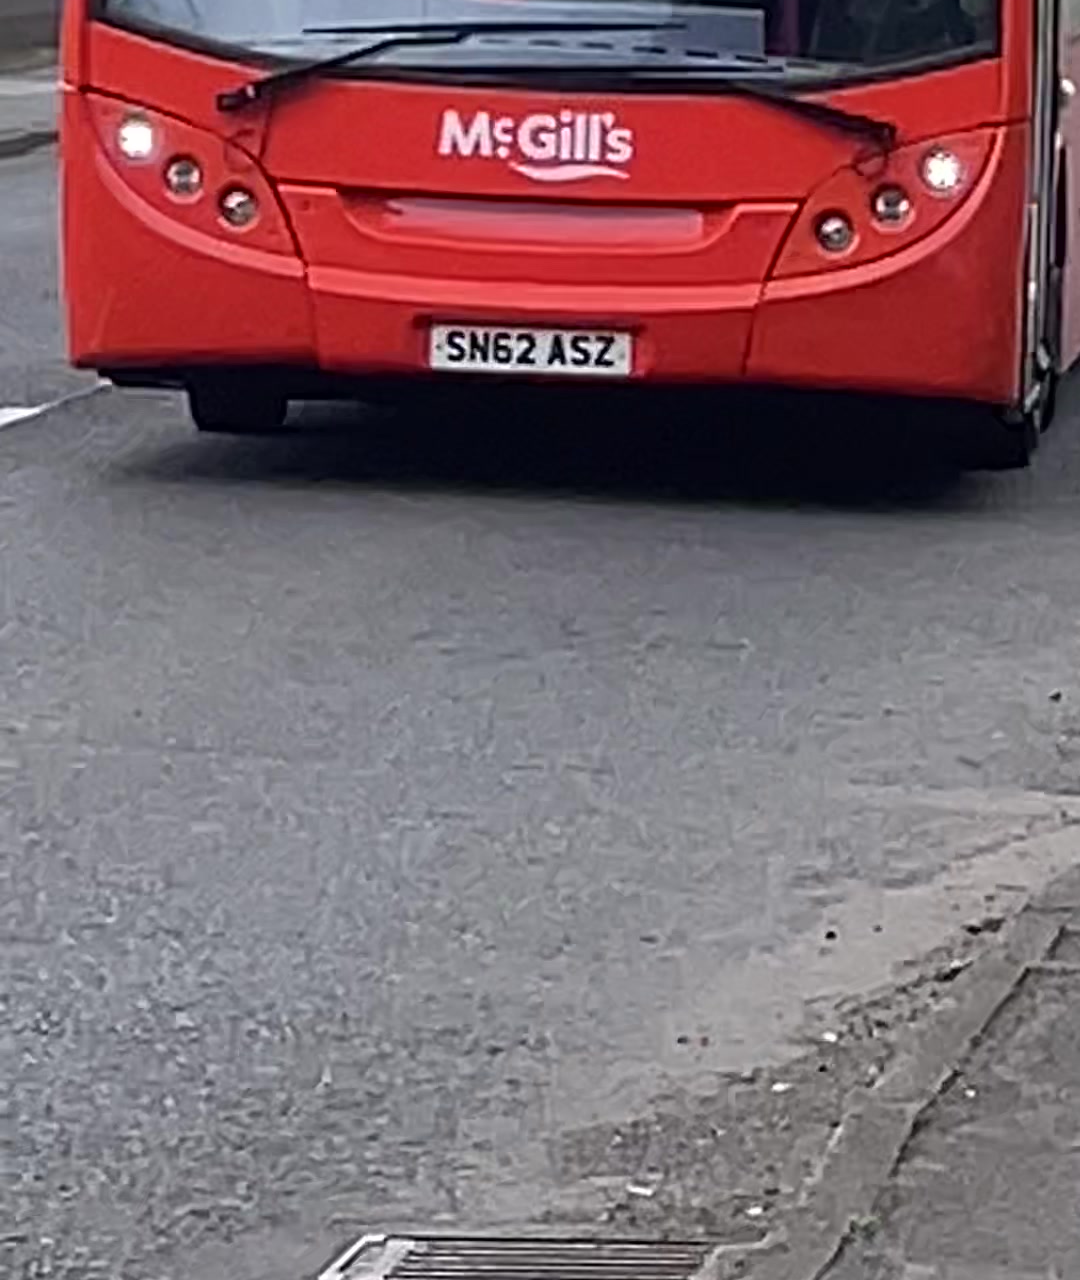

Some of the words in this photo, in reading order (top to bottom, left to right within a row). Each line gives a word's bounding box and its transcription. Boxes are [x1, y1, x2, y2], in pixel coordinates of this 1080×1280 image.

[437, 109, 633, 163] McGill's
[446, 331, 536, 365] SN62
[547, 333, 615, 367] ASZ
